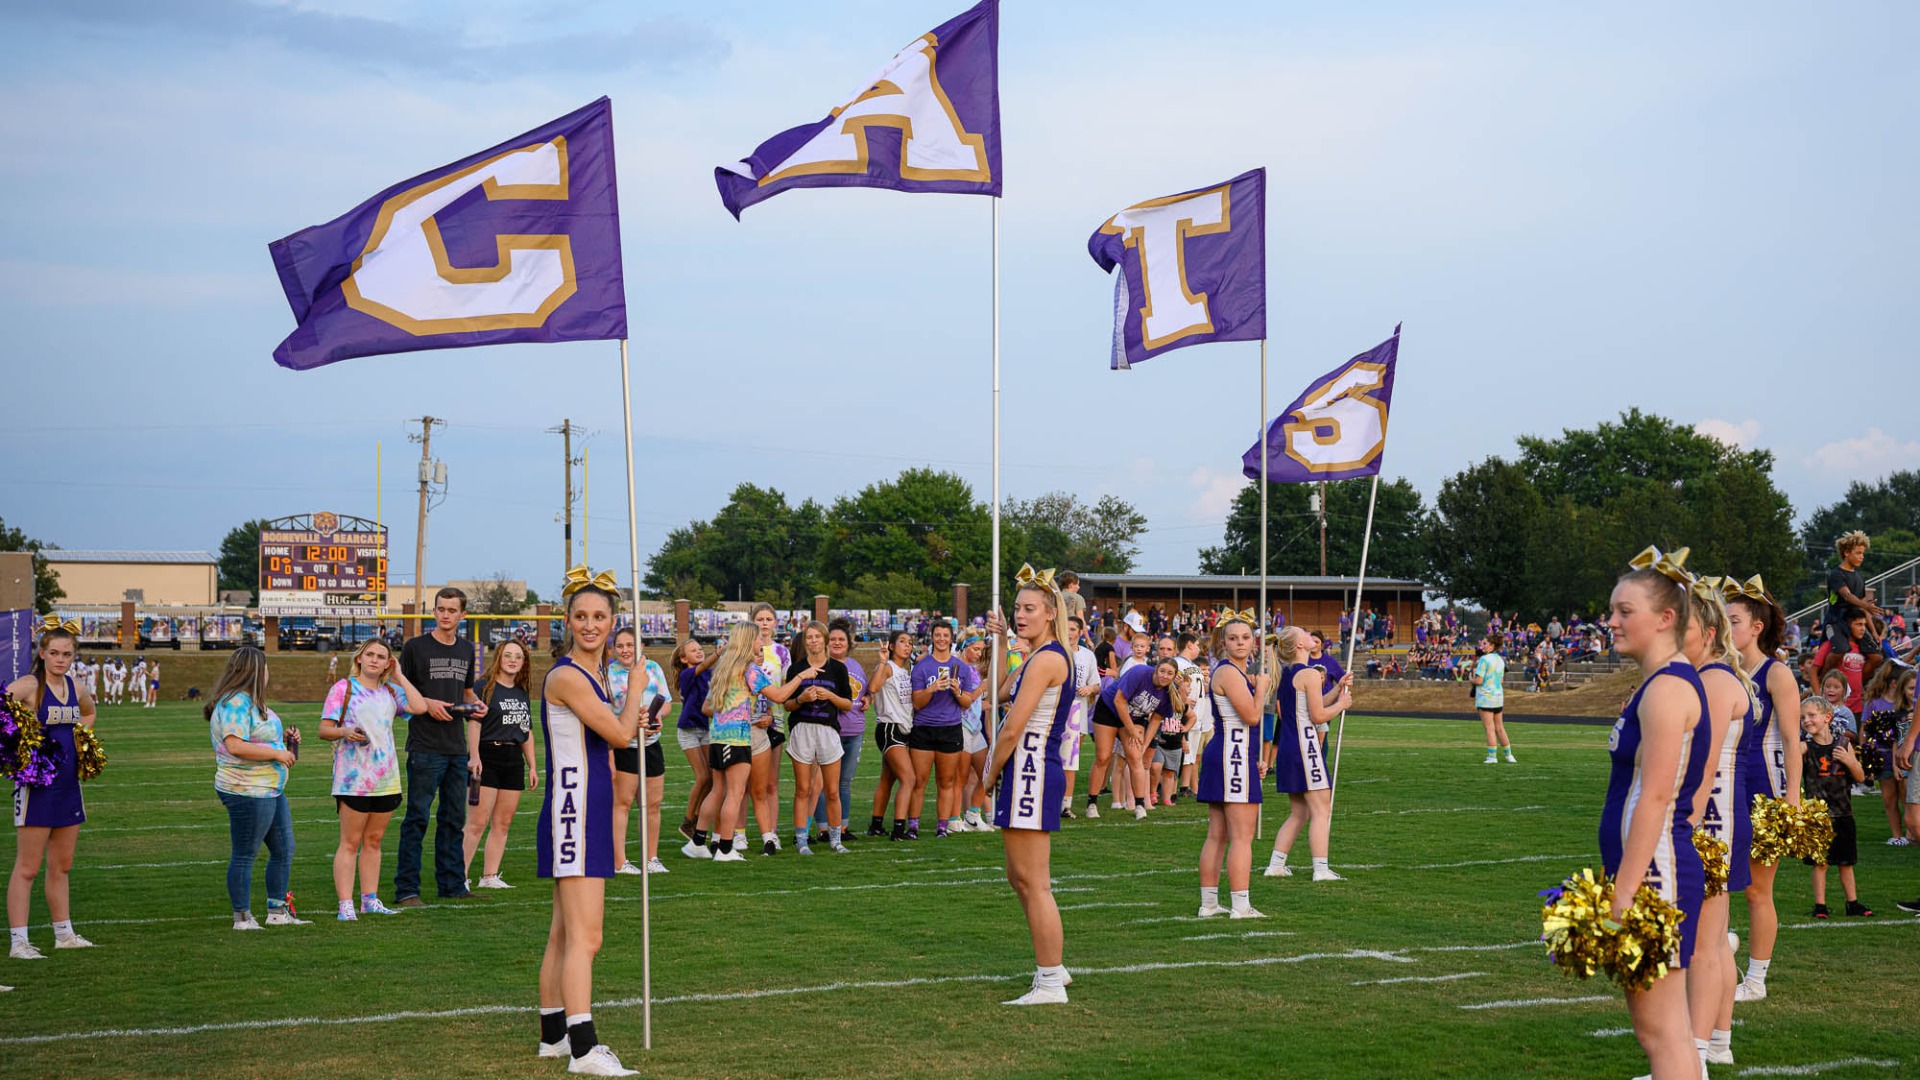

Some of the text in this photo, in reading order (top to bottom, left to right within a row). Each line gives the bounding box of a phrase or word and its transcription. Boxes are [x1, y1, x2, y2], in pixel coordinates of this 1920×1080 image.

[758, 32, 991, 187] A
[340, 135, 578, 337] C
[1099, 184, 1231, 351] T
[262, 532, 386, 545] BOONEVILLE BEARCATS
[265, 546, 290, 556] HOME
[307, 546, 347, 561] 12:00
[270, 556, 281, 571] 0
[284, 564, 292, 575] 0
[313, 564, 328, 574] QTR
[333, 564, 338, 576] 1
[356, 565, 364, 576] 3
[267, 575, 272, 590] 1
[272, 578, 292, 587] DOWN
[303, 575, 317, 590] 10
[318, 579, 337, 587] TO GO
[341, 579, 367, 588] BALL ON
[326, 594, 350, 605] HUG
[46, 706, 81, 725] BHS
[1230, 728, 1243, 793] CATS
[1304, 726, 1322, 783] CATS
[1018, 731, 1040, 817] CATS
[560, 767, 578, 864] CATS
